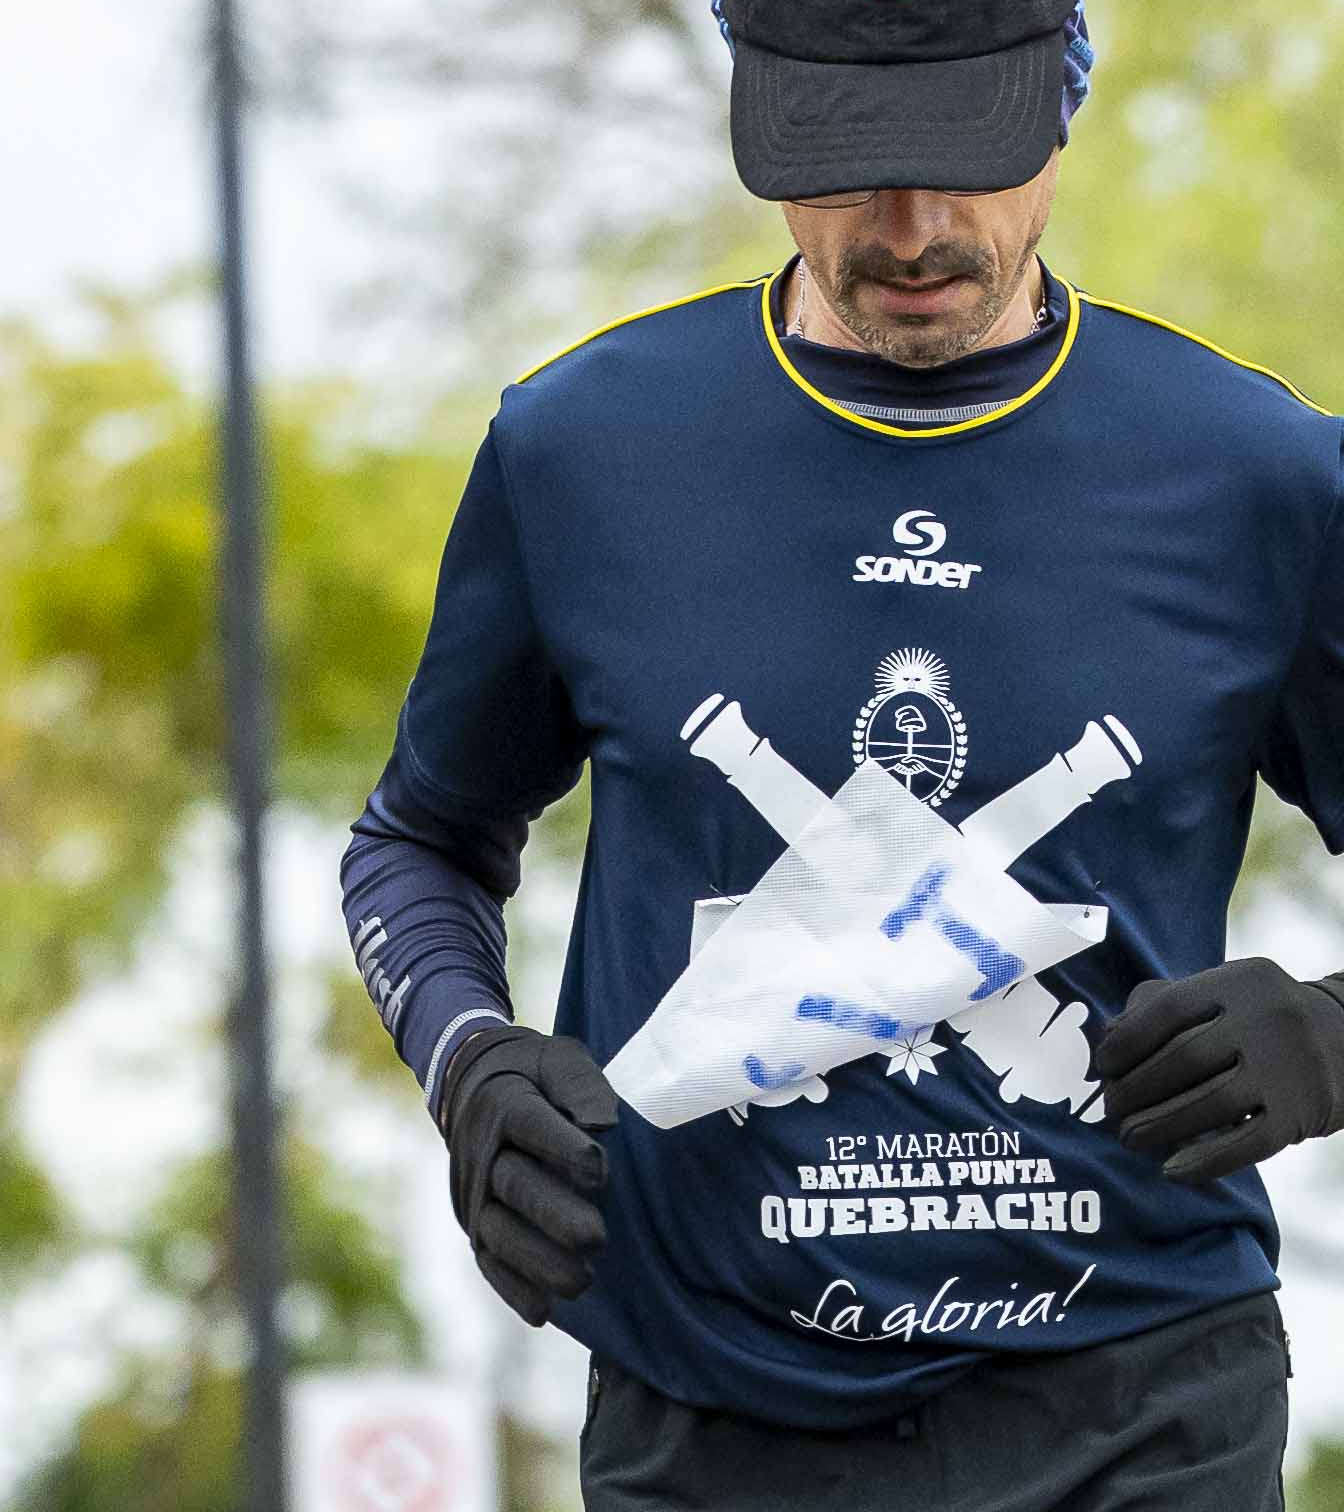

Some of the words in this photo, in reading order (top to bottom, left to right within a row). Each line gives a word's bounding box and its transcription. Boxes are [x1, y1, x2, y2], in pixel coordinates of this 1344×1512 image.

[876, 1126, 1020, 1160] MARATÓN
[798, 1162, 944, 1190] BATALLA
[948, 1158, 1056, 1186] PUNTA
[760, 1189, 1102, 1244] QUEBRACHO
[790, 1279, 863, 1341] La
[880, 1263, 1097, 1342] gloria!
